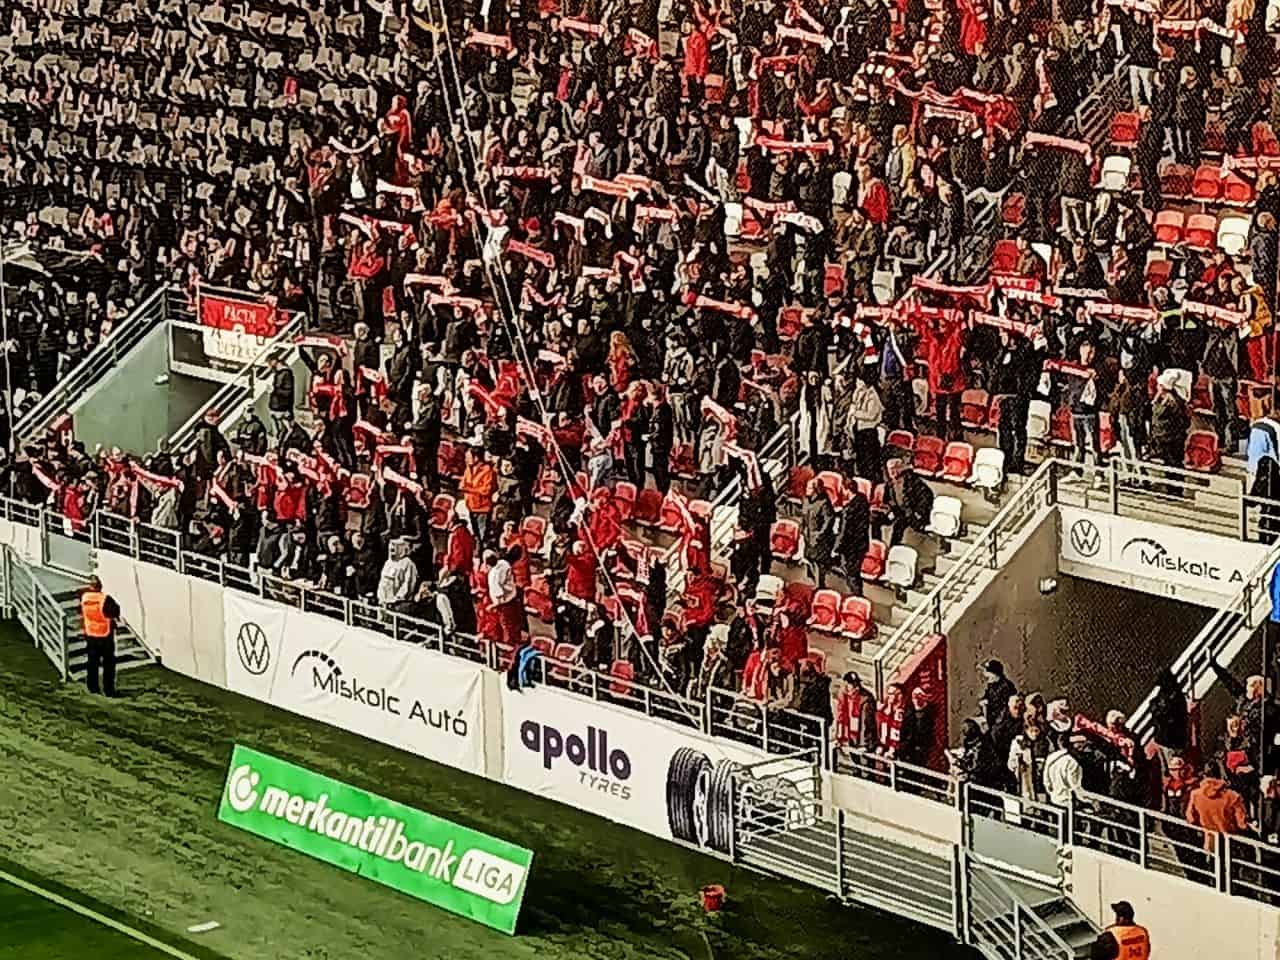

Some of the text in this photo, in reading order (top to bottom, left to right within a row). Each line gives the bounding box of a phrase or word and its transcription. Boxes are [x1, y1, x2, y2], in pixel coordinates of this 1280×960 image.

[1140, 549, 1221, 581] Miskolc
[312, 665, 468, 737] Miskolc Autó
[520, 719, 632, 780] apollo
[578, 771, 632, 800] TYRES
[259, 784, 514, 896] merkantilbank LIGA
